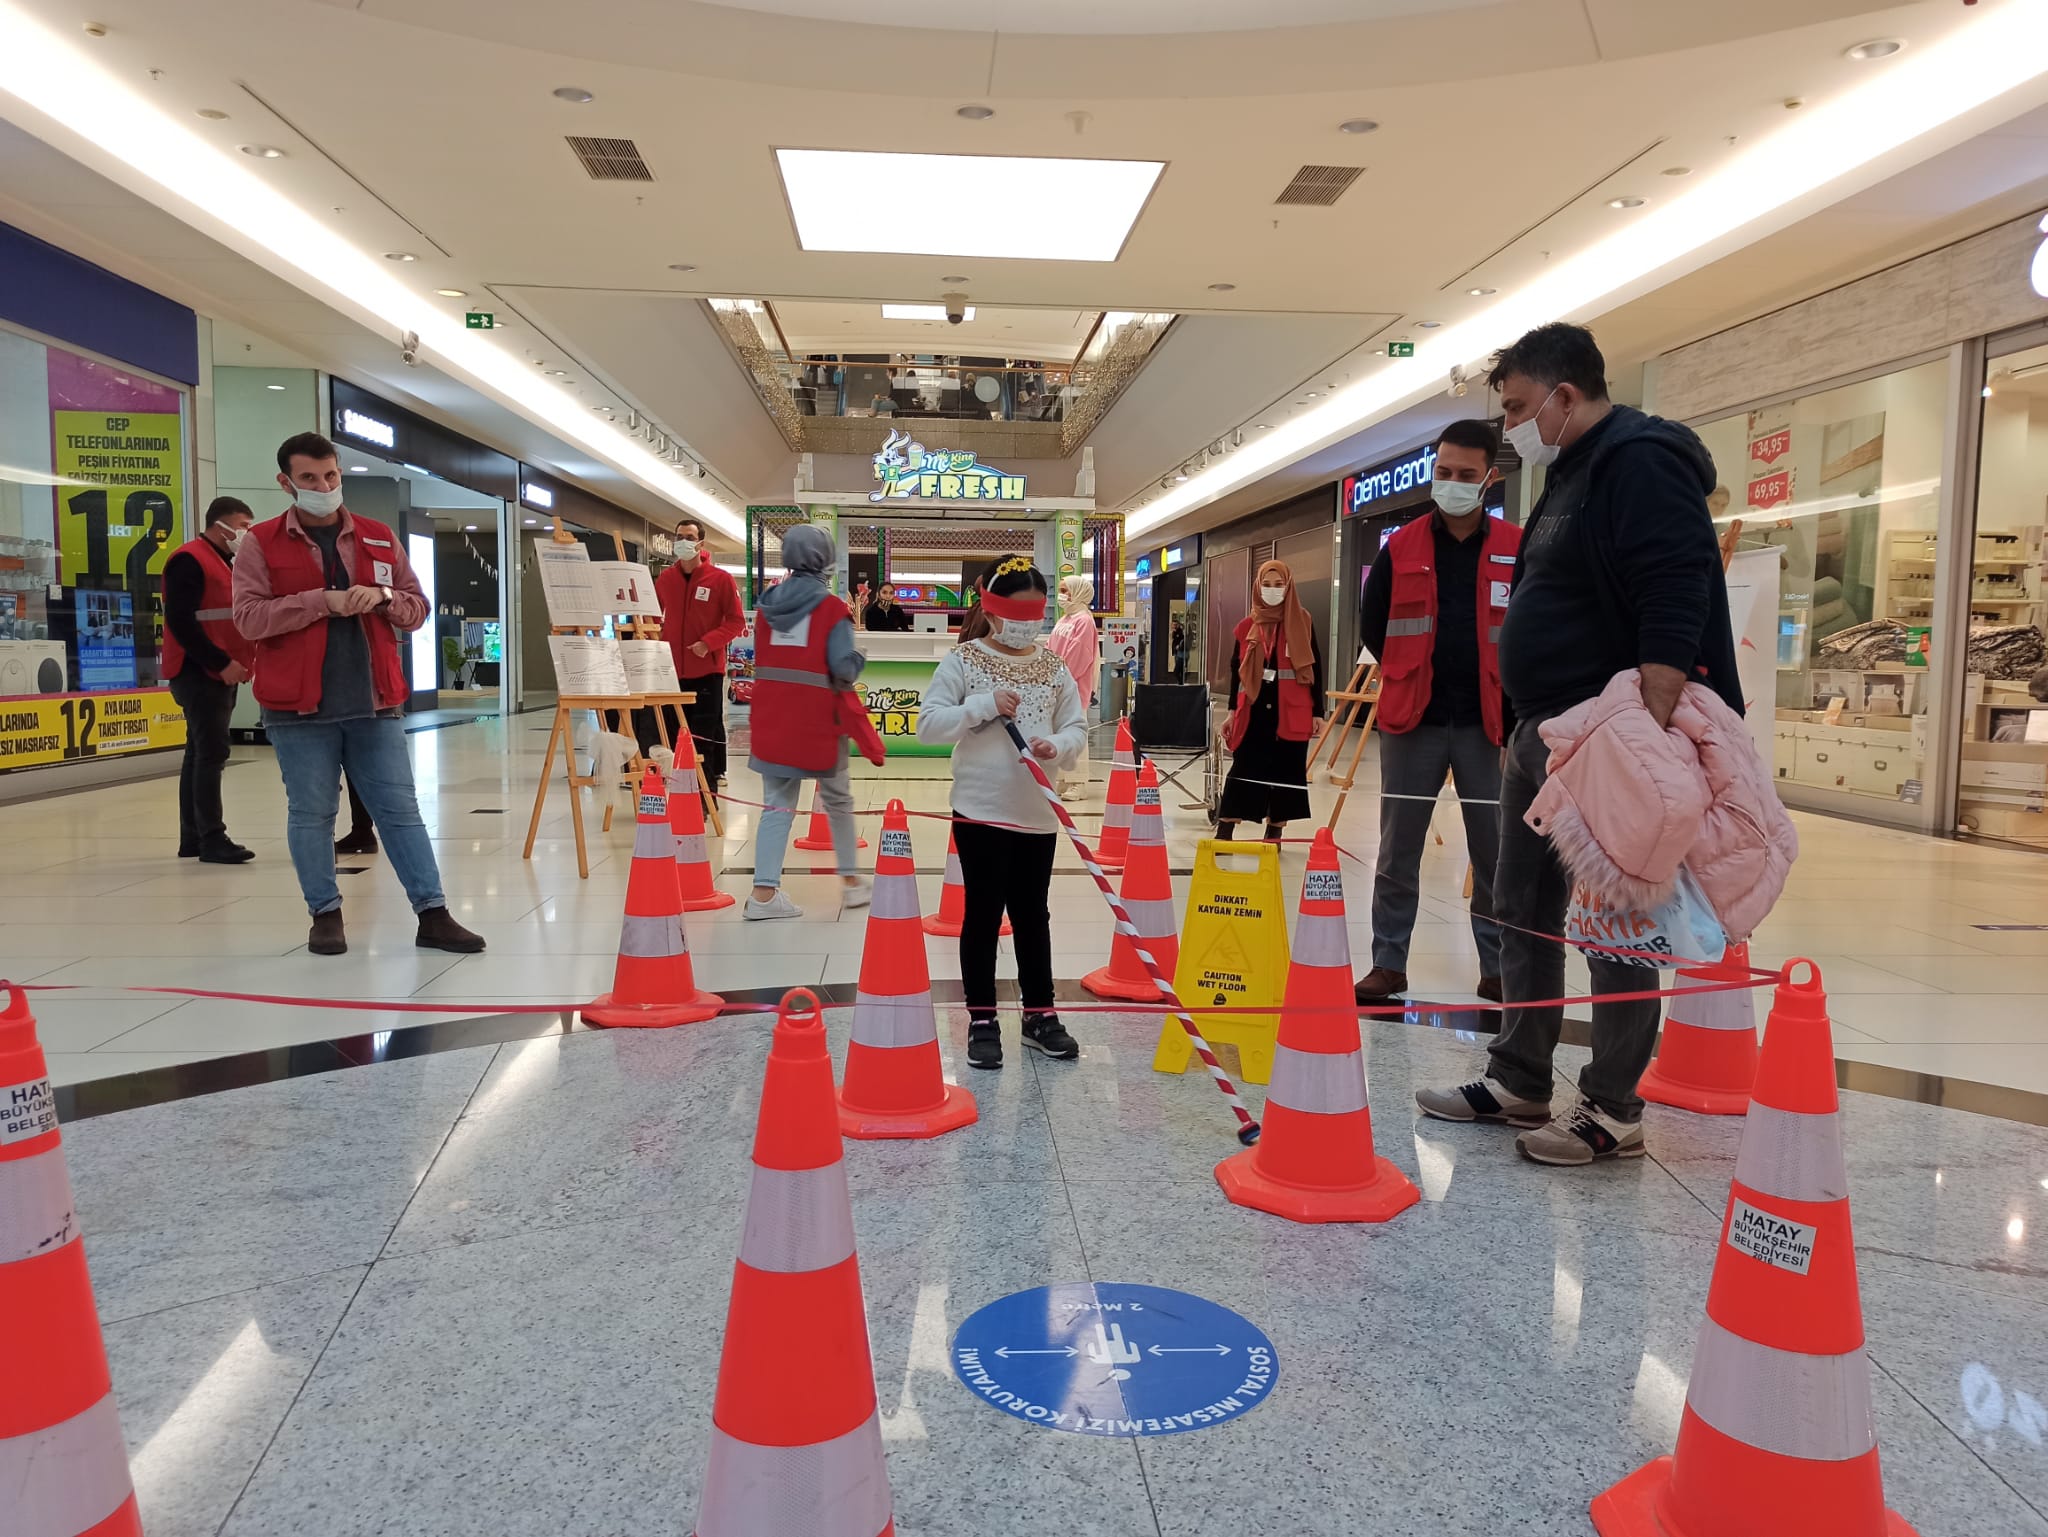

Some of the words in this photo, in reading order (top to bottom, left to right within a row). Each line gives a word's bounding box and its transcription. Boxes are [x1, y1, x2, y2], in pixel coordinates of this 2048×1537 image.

[106, 417, 129, 431] CEP
[66, 435, 170, 451] TELEFONLARINDA
[78, 453, 110, 469] PEŞİN
[112, 454, 160, 469] FİYATINA
[110, 473, 172, 487] MASRAFSIZ
[919, 475, 1026, 500] FRESH
[1353, 471, 1391, 512] pierre
[104, 700, 118, 716] AYA
[119, 699, 142, 714] KADAR
[60, 698, 97, 760] 12
[98, 719, 123, 737] TAKSİT
[123, 719, 149, 736] FIRSATI
[15, 734, 60, 755] MASRAFSIZ
[885, 833, 910, 841] HATAY
[1309, 874, 1339, 883] HATAY
[1198, 904, 1231, 915] KAYGAN
[1234, 908, 1262, 918] ZEMİN
[1204, 971, 1241, 982] CAUTION
[1197, 979, 1216, 989] WET
[1218, 982, 1247, 992] FLOOR
[1743, 1209, 1801, 1240] HATAY
[1734, 1219, 1810, 1256] BÜYÜKŞEHİR
[1734, 1233, 1804, 1267] BELEDİYESİ
[1129, 1303, 1144, 1311] 2
[1234, 1346, 1272, 1396] SOSYAL
[958, 1348, 1069, 1424] KORUYALIM!
[1074, 1396, 1245, 1435] MESAFEMİZİ
